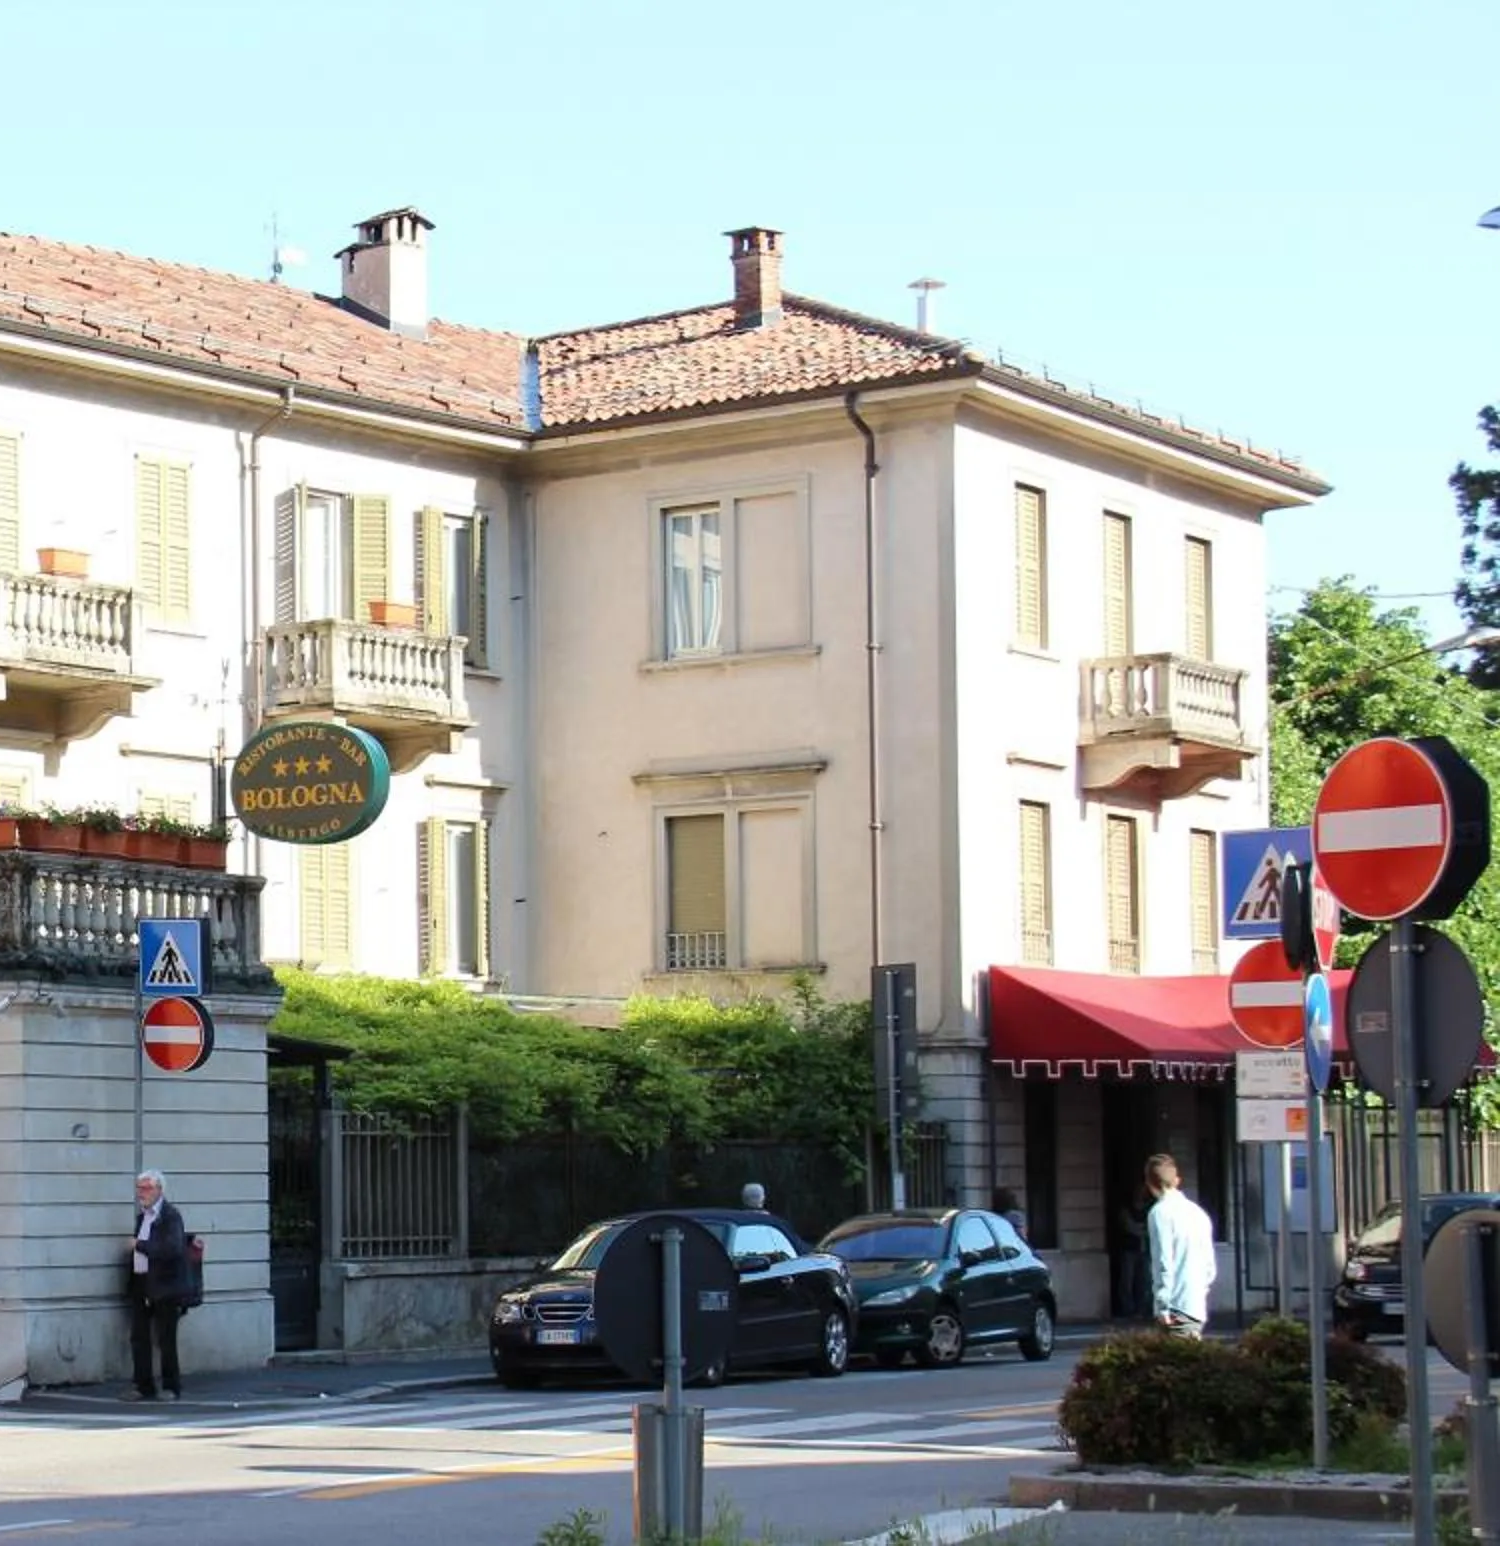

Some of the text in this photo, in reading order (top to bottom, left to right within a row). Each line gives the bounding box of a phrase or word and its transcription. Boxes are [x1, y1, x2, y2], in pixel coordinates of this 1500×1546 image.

[237, 725, 326, 777] RISTORANTE
[340, 736, 367, 767] BAR
[242, 781, 365, 811] BOLOGNA
[266, 818, 341, 838] ALBERGO
